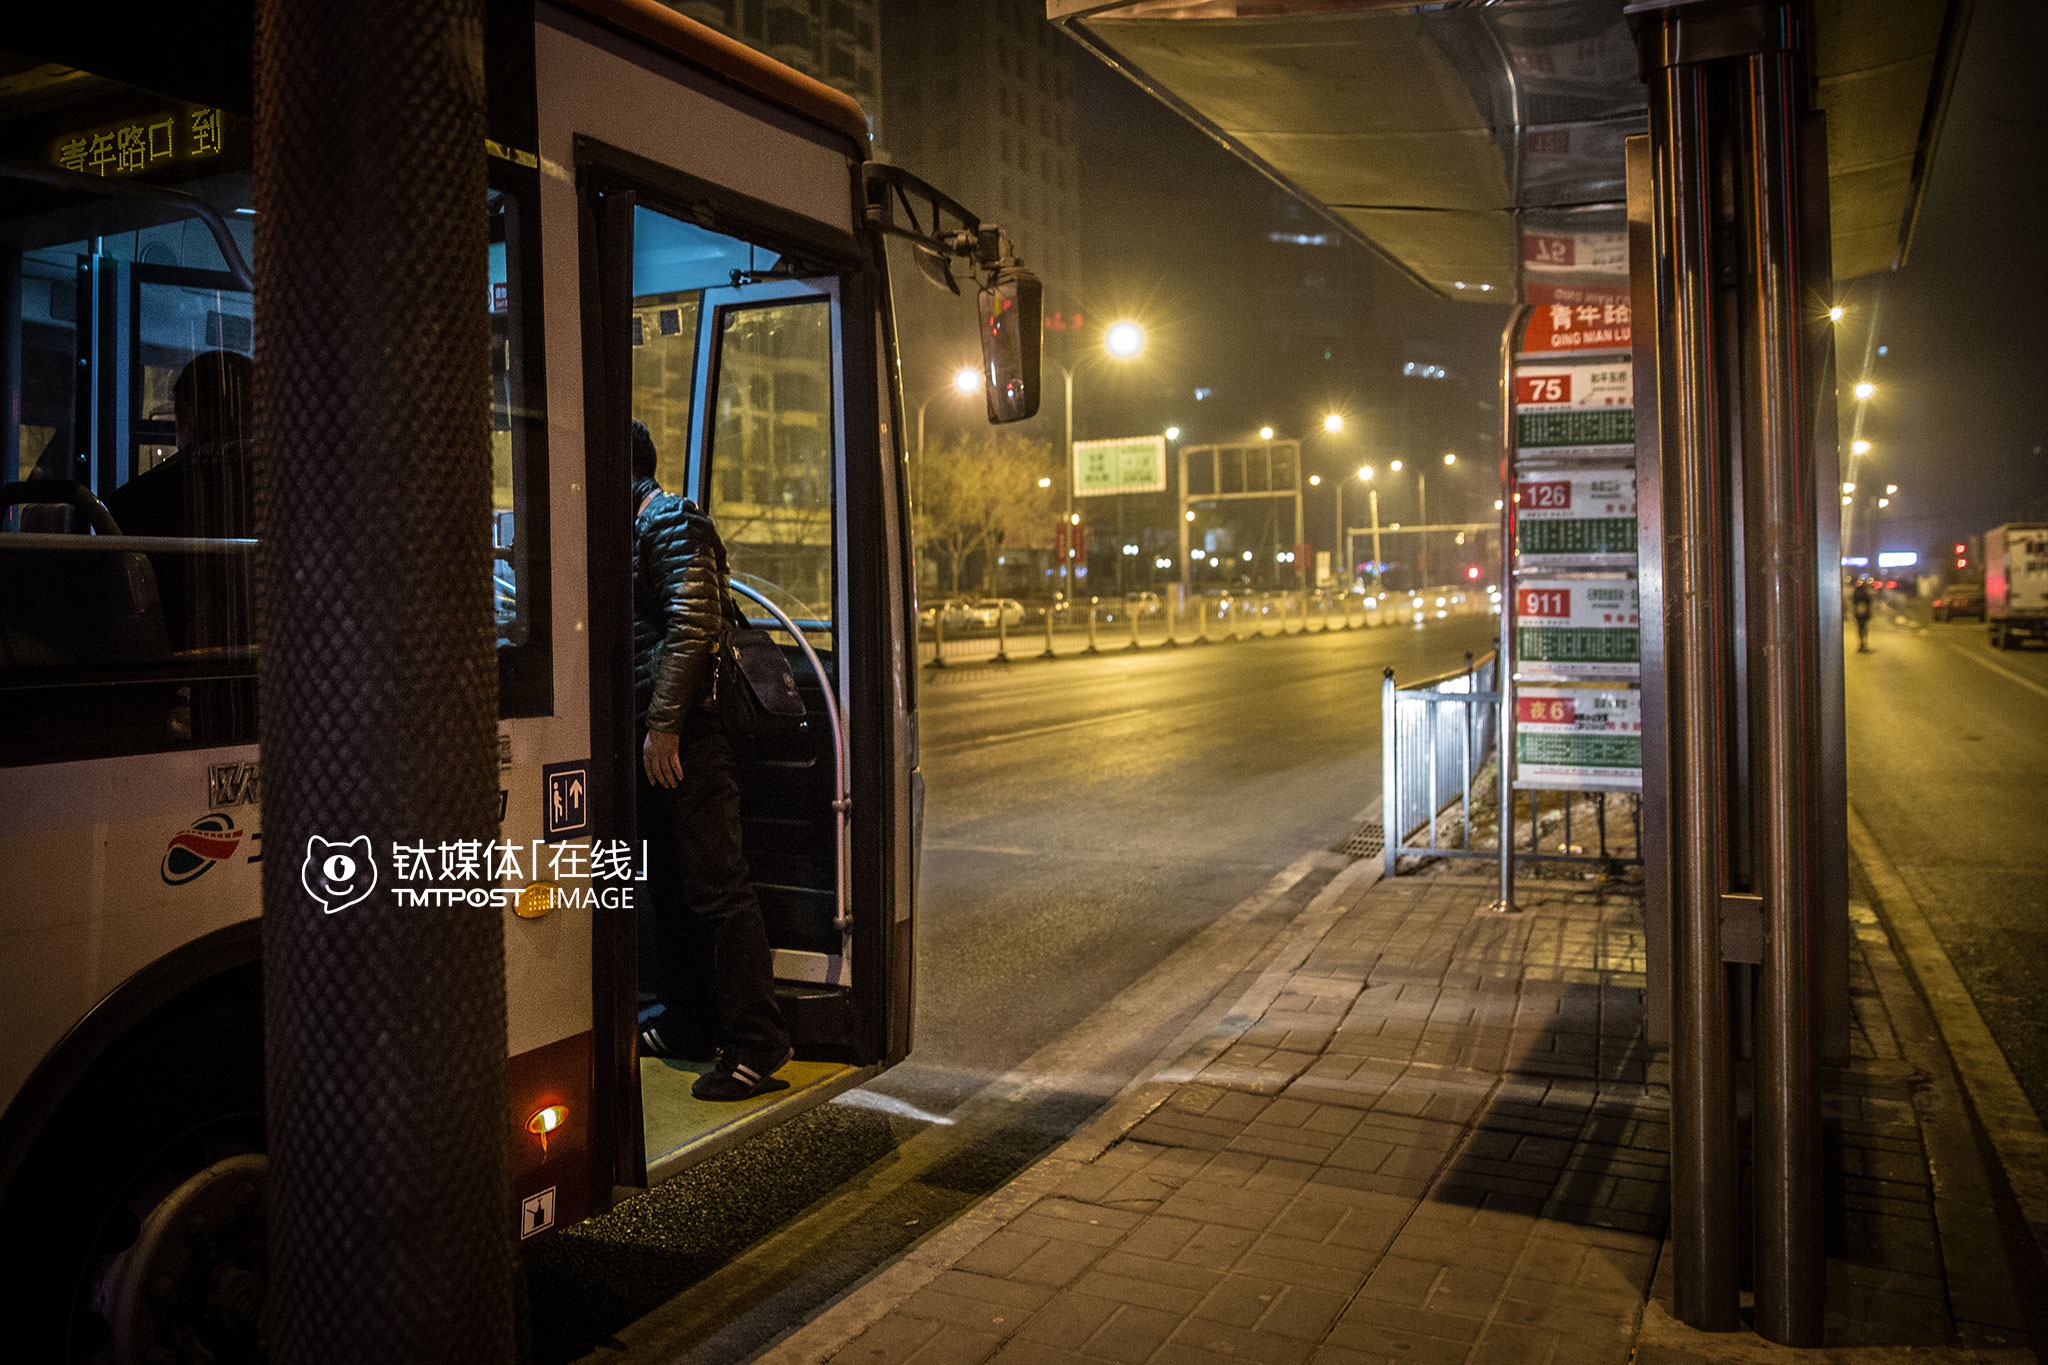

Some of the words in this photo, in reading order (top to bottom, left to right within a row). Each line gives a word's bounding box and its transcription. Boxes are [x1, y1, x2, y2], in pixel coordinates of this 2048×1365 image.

[60, 117, 174, 177] 青年路口
[191, 108, 222, 155] 到
[1550, 303, 1631, 332] 青年路
[1551, 331, 1581, 347] QING
[1582, 329, 1613, 344] NIAN
[1614, 327, 1631, 341] LU
[1529, 379, 1562, 401] 75
[1527, 485, 1566, 506] 126
[1527, 592, 1562, 614] 911
[1530, 700, 1565, 721] 夜6
